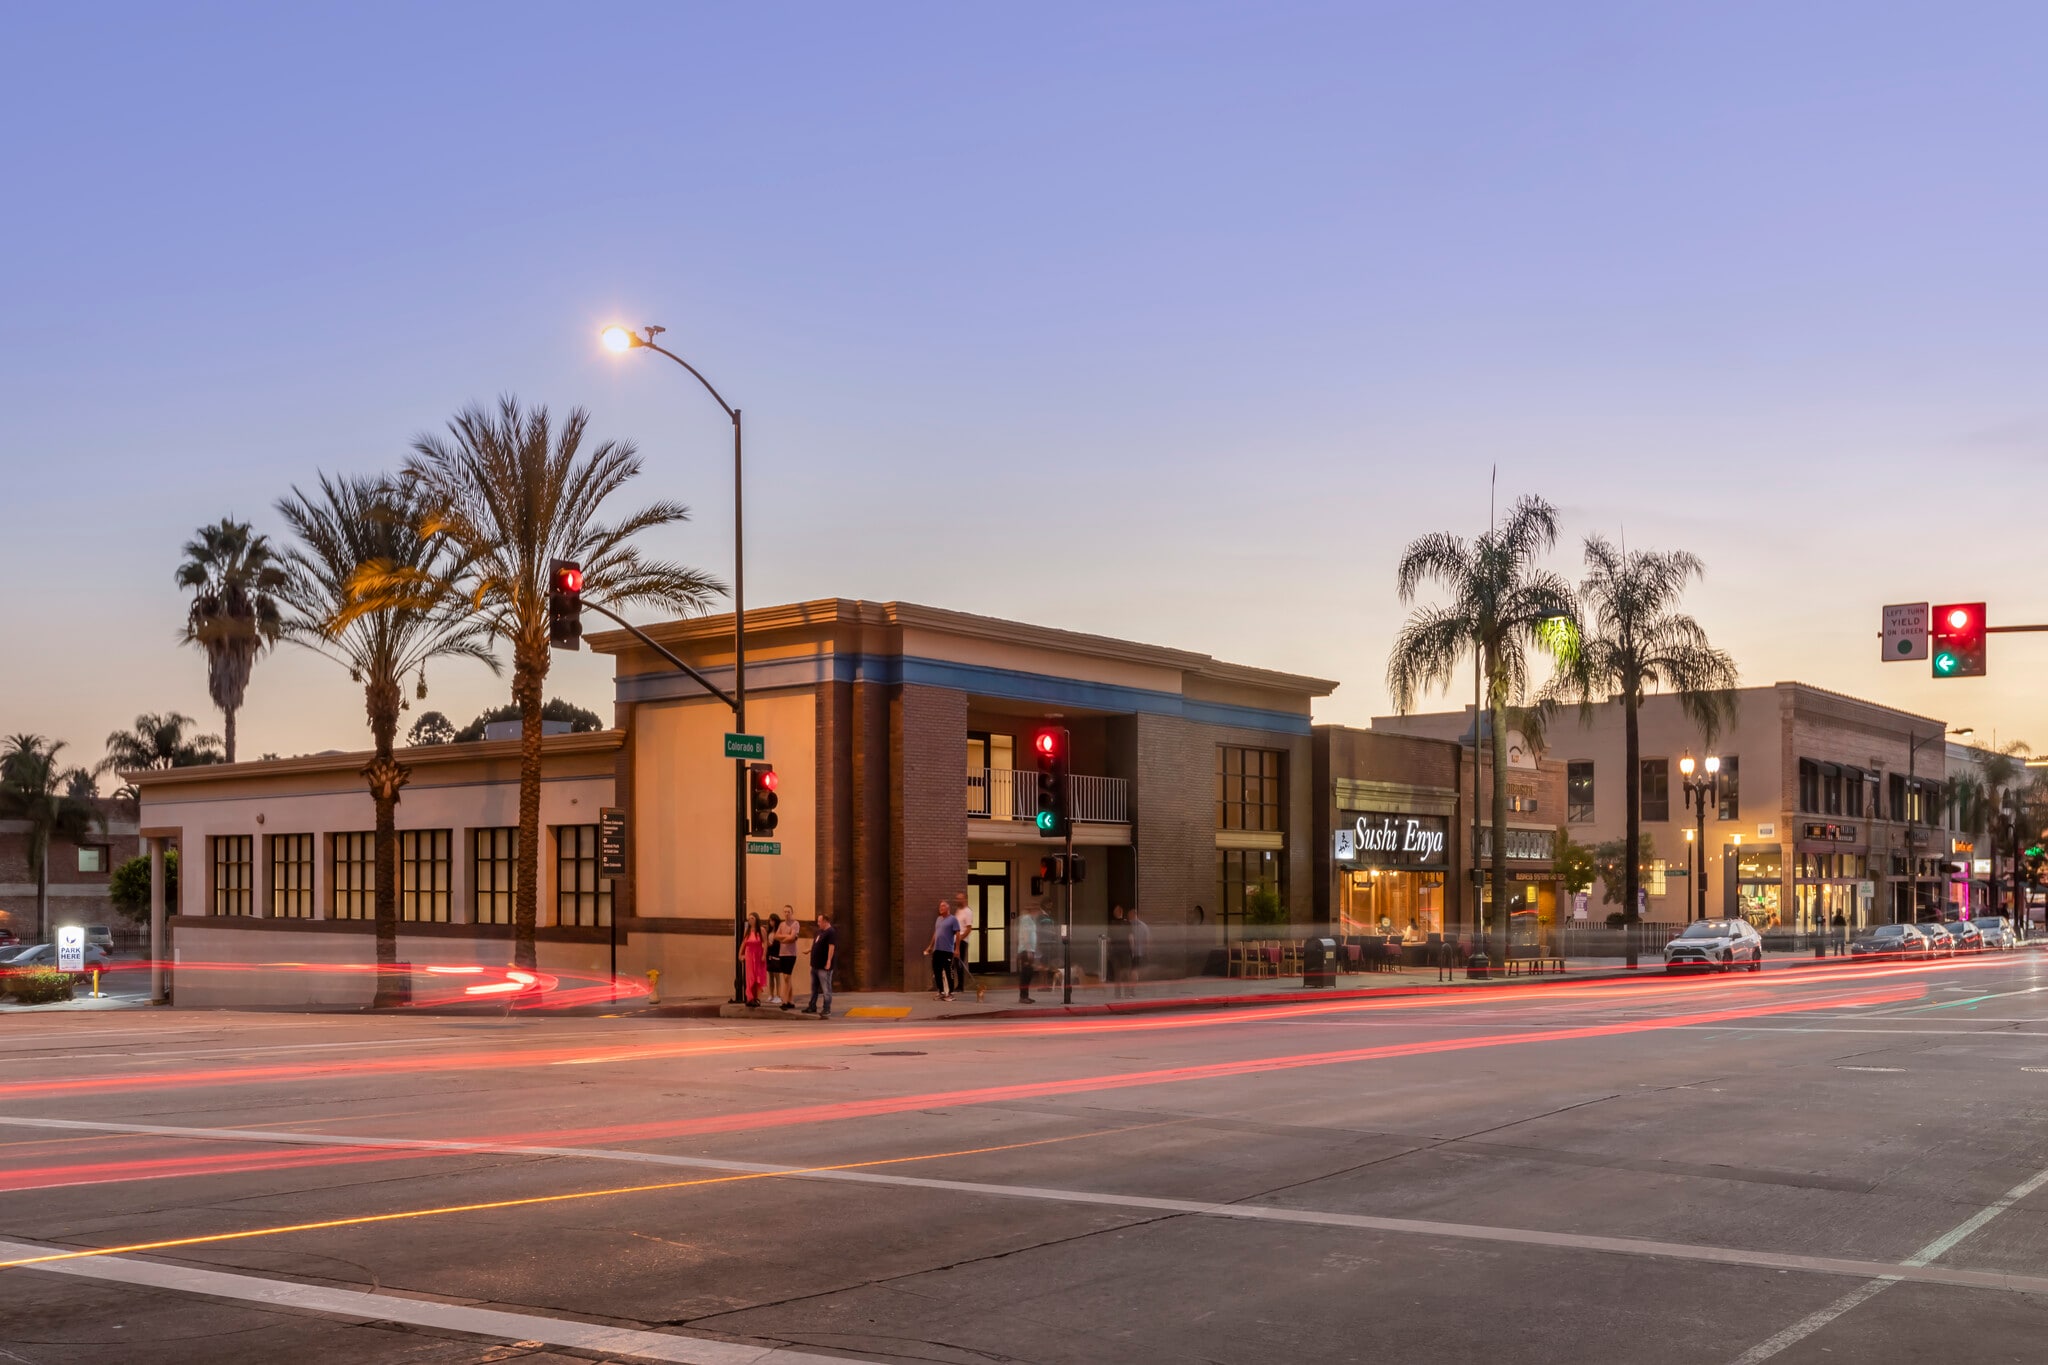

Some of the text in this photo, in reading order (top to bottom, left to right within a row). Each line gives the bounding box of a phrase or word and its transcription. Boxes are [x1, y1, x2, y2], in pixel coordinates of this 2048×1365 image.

[1891, 617, 1920, 626] YIELD
[727, 740, 754, 752] Colorado
[1355, 816, 1399, 851] Sushi
[1402, 819, 1444, 862] Enya
[746, 842, 770, 853] Colorado
